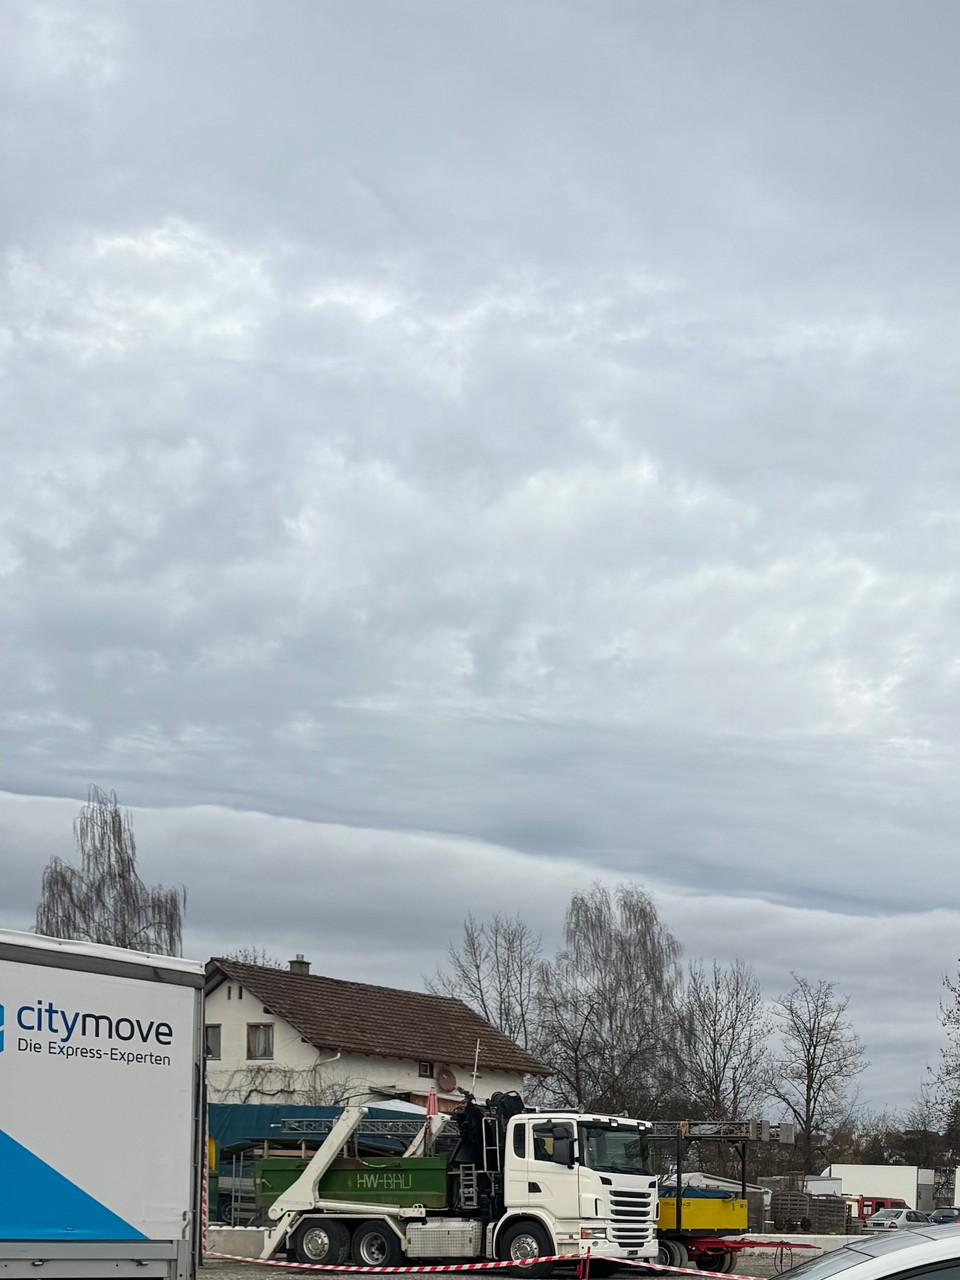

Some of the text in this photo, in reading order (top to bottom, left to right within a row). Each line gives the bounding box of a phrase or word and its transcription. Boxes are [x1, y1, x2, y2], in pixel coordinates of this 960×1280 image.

[17, 1000, 173, 1045] citymove
[18, 1038, 171, 1066] Die Express-Experten
